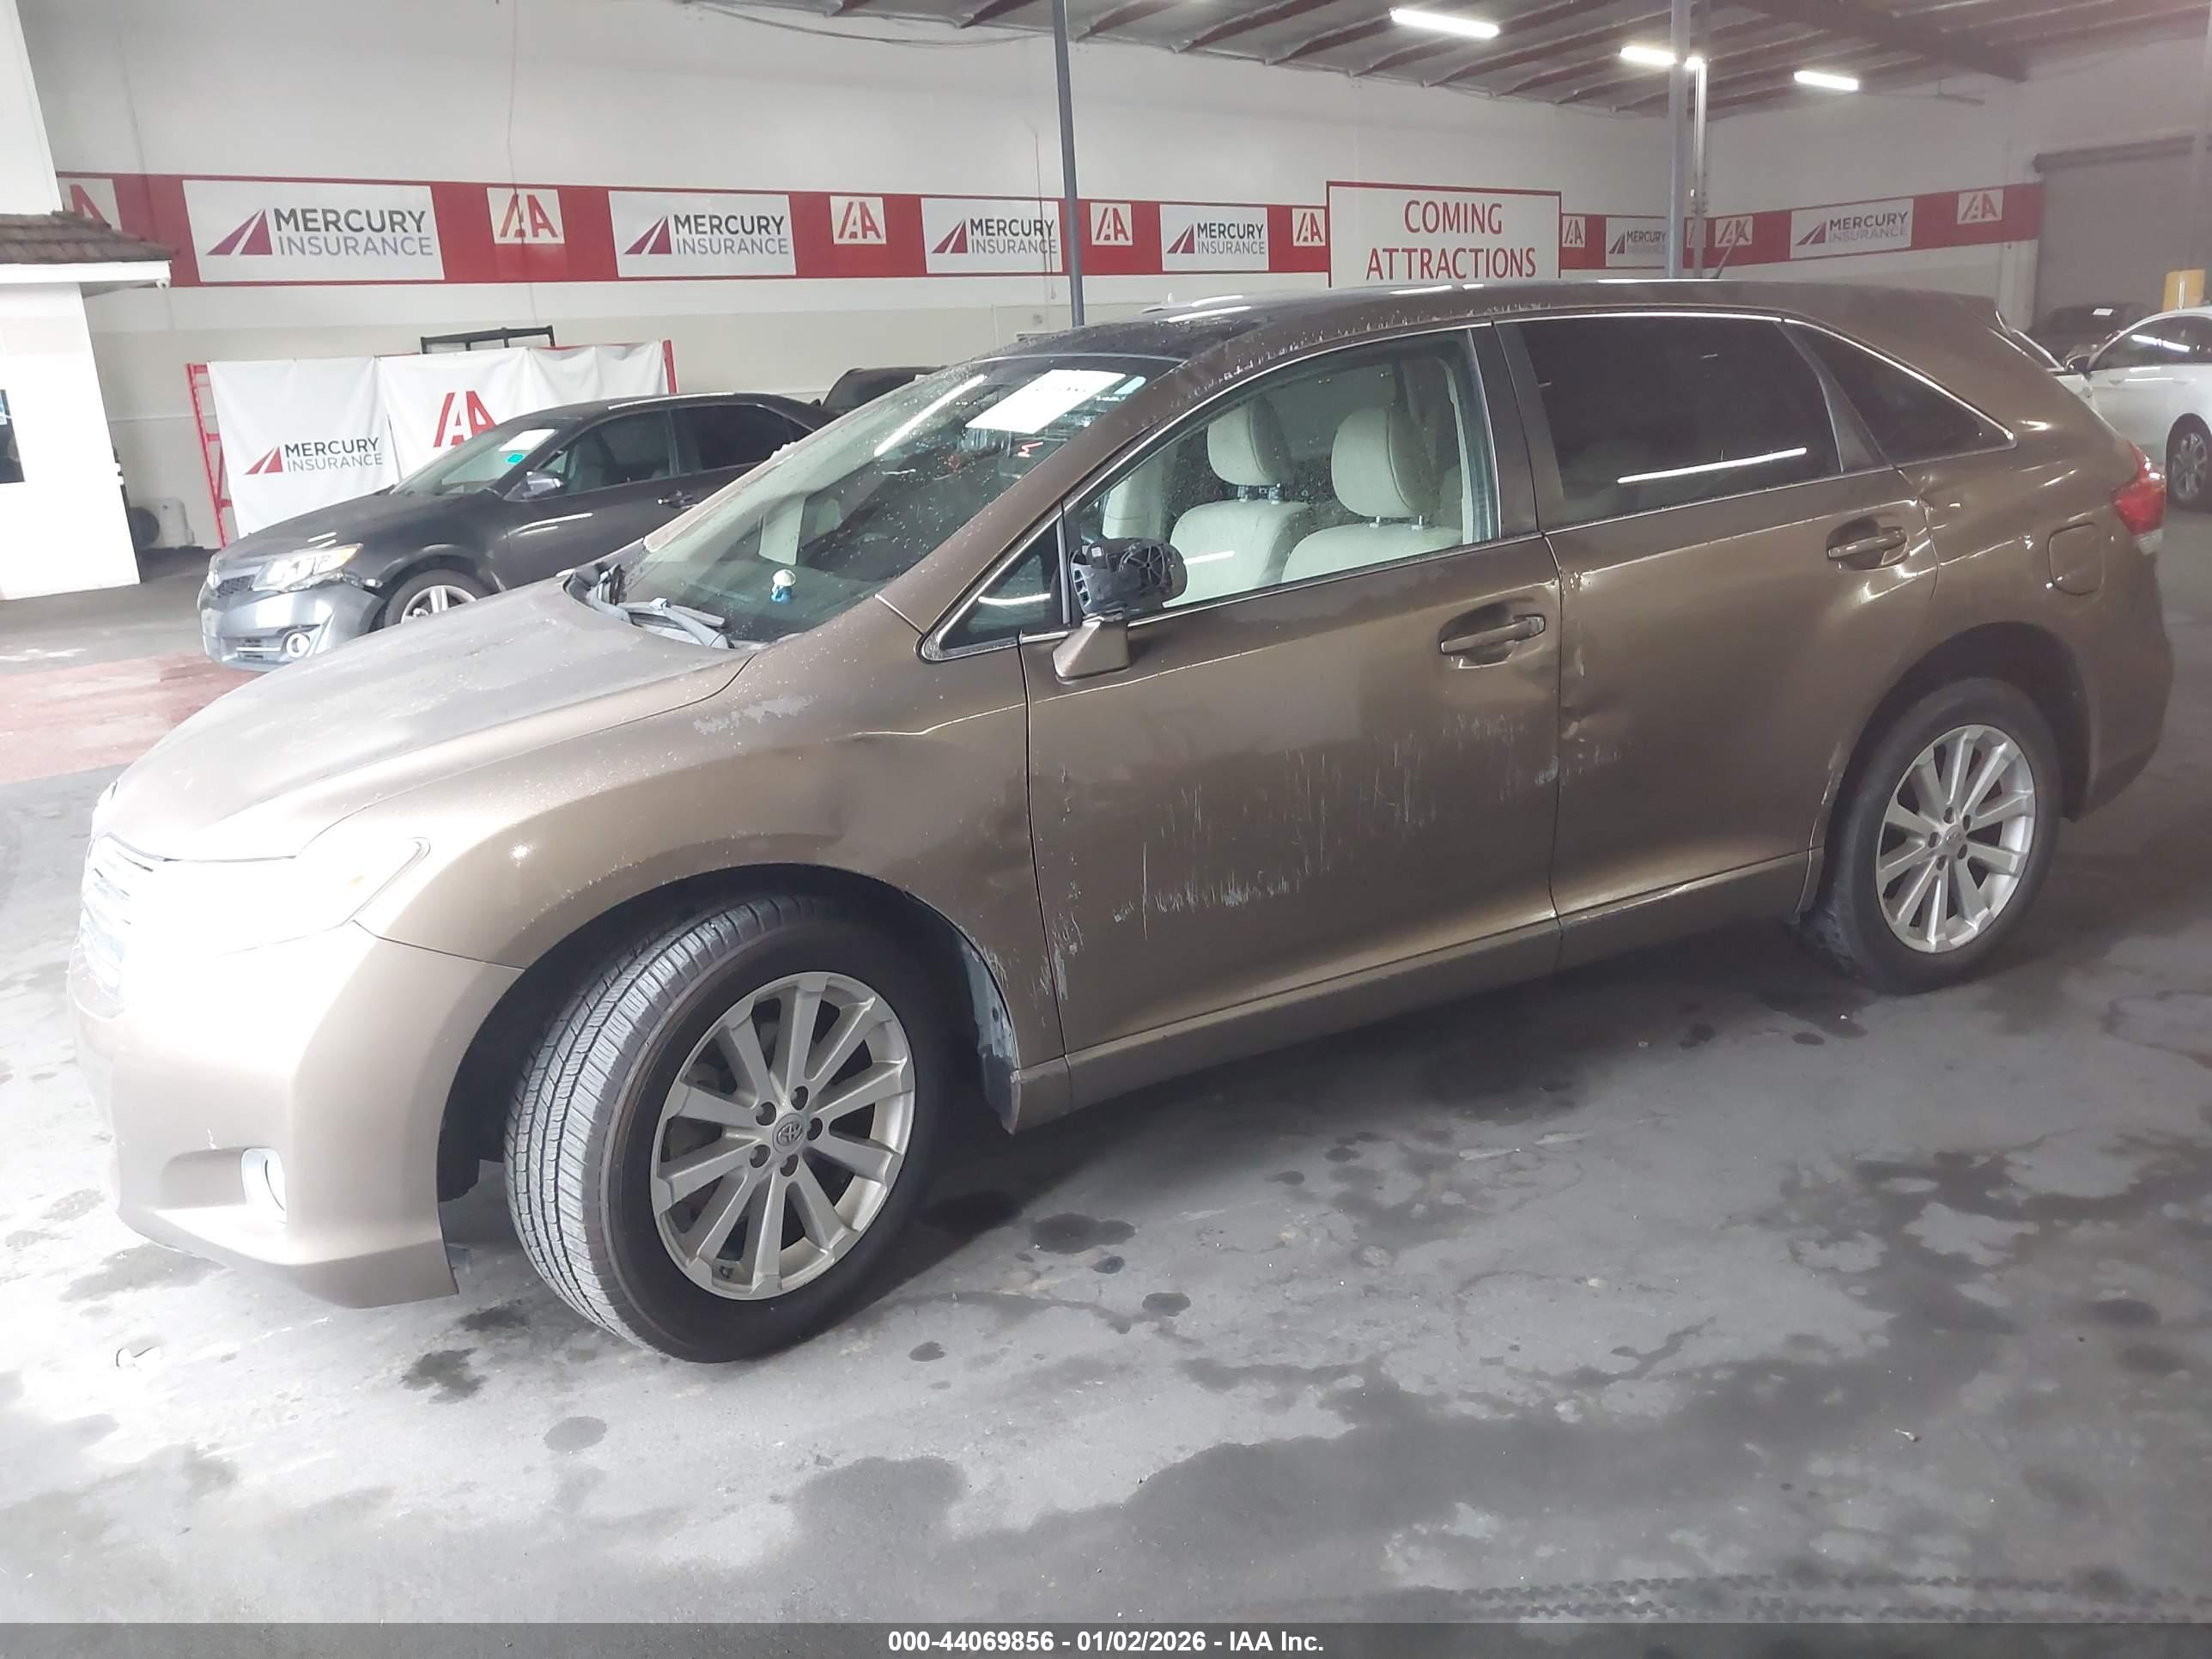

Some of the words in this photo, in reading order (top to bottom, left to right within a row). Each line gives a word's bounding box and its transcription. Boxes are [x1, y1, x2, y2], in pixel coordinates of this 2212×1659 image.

[274, 207, 426, 234] MERCURY
[673, 214, 785, 235] MERCURY
[1404, 199, 1503, 234] COMING
[1829, 211, 1908, 231] MERCURY
[969, 218, 1054, 237] MERCURY
[1197, 222, 1264, 240] MERCURY
[1626, 230, 1666, 243] MERCURY
[277, 235, 434, 256] INSURANCE
[676, 237, 789, 255] INSURANCE
[971, 239, 1057, 254] INSURANCE
[1198, 240, 1265, 255] INSURANCE
[1365, 247, 1536, 281] ATTRACTIONS
[285, 437, 379, 459] MERCURY
[287, 453, 384, 472] INSURANCE
